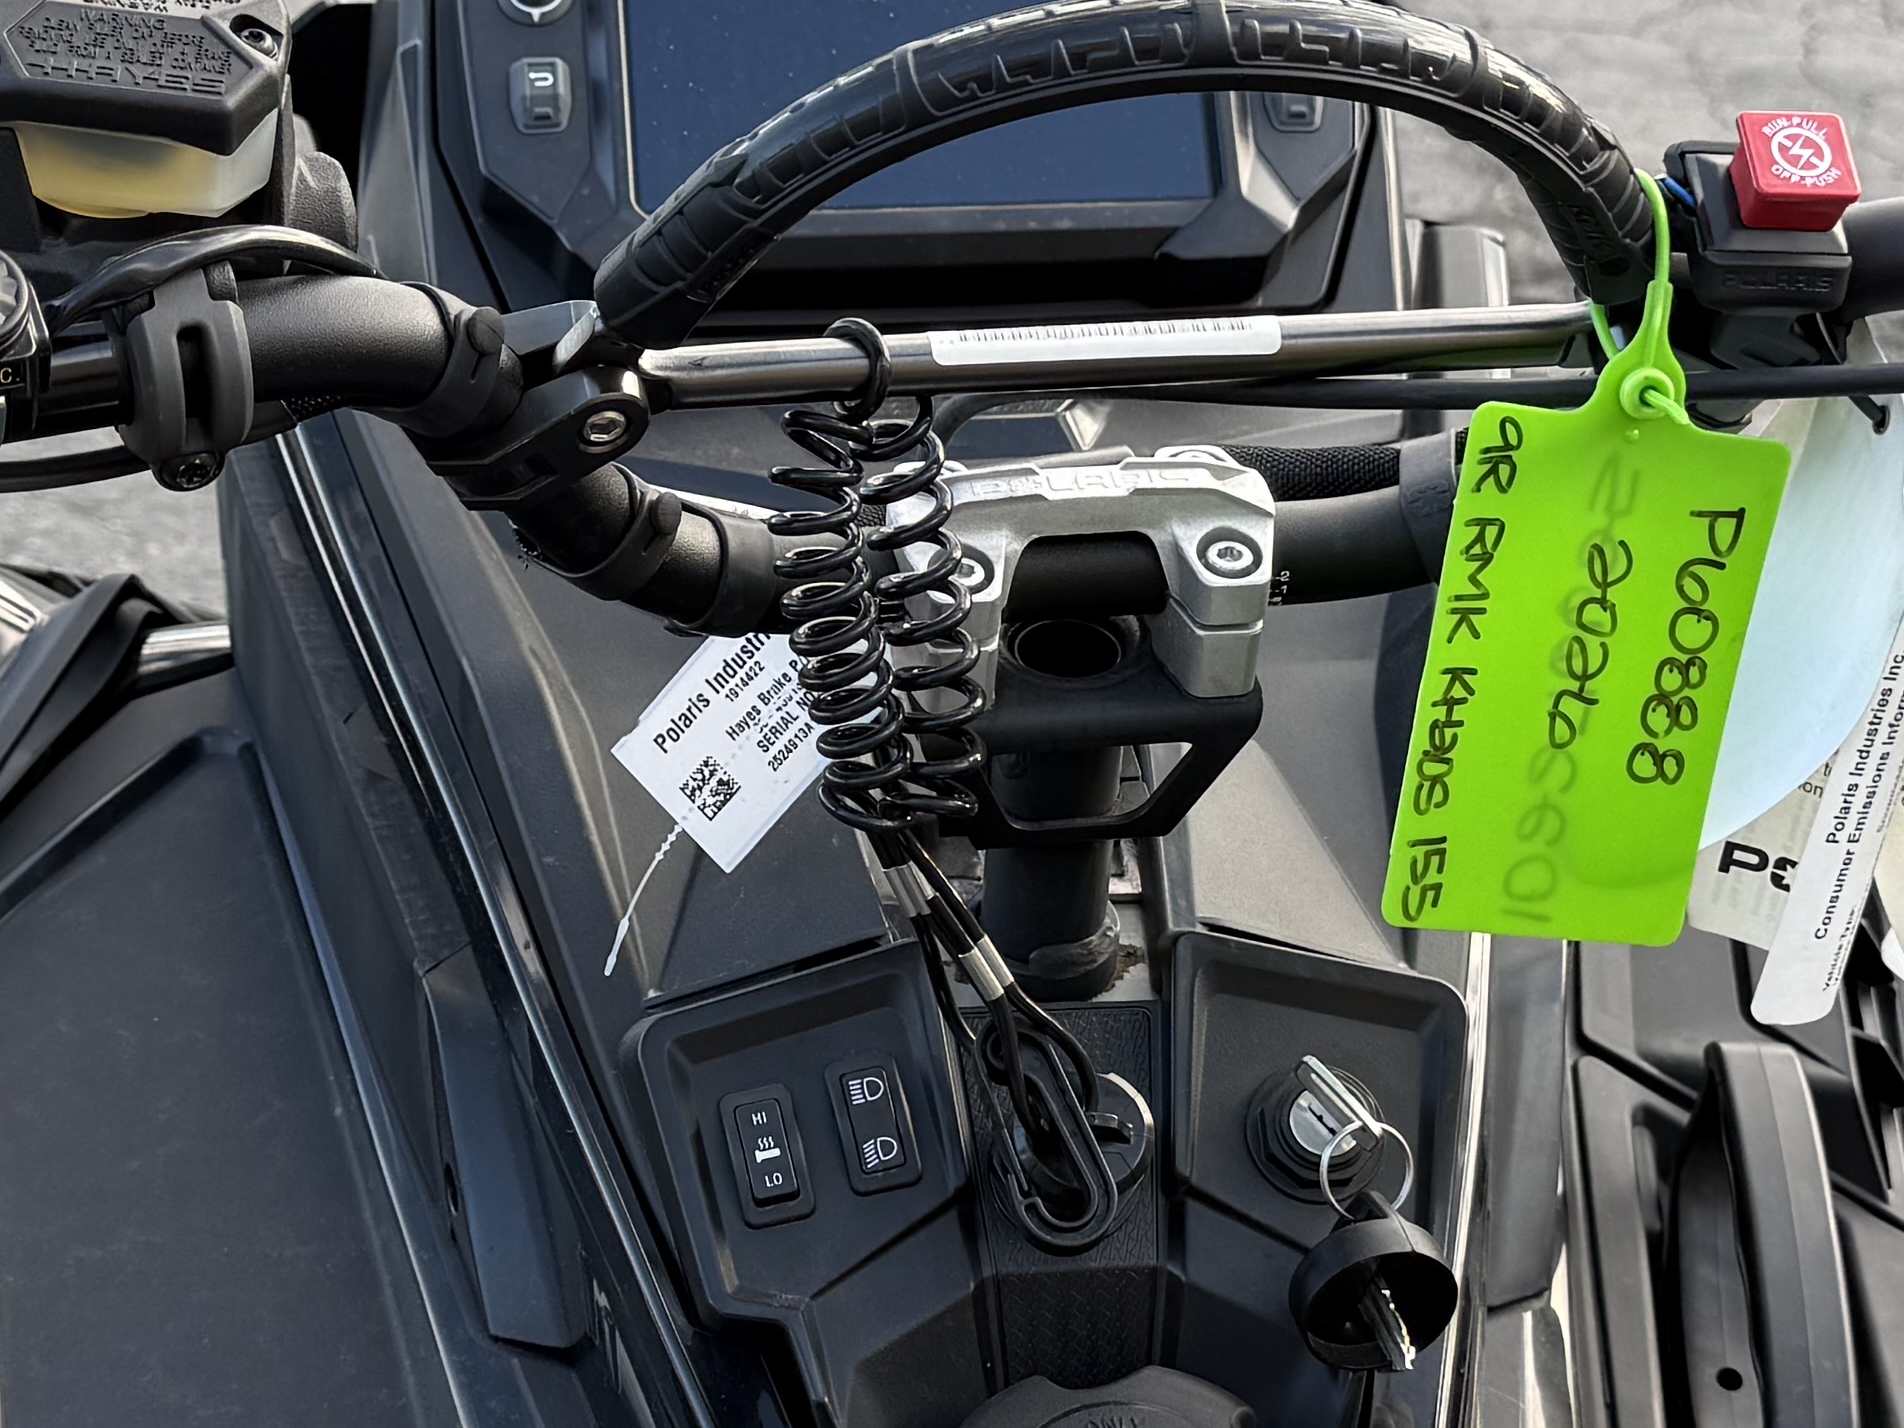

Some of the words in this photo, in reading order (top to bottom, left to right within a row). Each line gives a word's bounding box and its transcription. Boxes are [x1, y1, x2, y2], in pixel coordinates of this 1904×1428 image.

[1445, 517, 1507, 645] RMK
[1547, 538, 1635, 751] 2026
[1625, 506, 1748, 786] P60888
[651, 692, 711, 754] Polaris
[724, 704, 762, 742] Hayes
[755, 710, 800, 753] SERIAL
[1824, 782, 1859, 844] Polaris
[1847, 686, 1893, 777] Industries
[1401, 836, 1448, 923] 155
[1813, 847, 1855, 940] Consumer
[1845, 750, 1891, 844] Emissions
[751, 1111, 768, 1126] HI
[764, 1172, 783, 1188] LO
